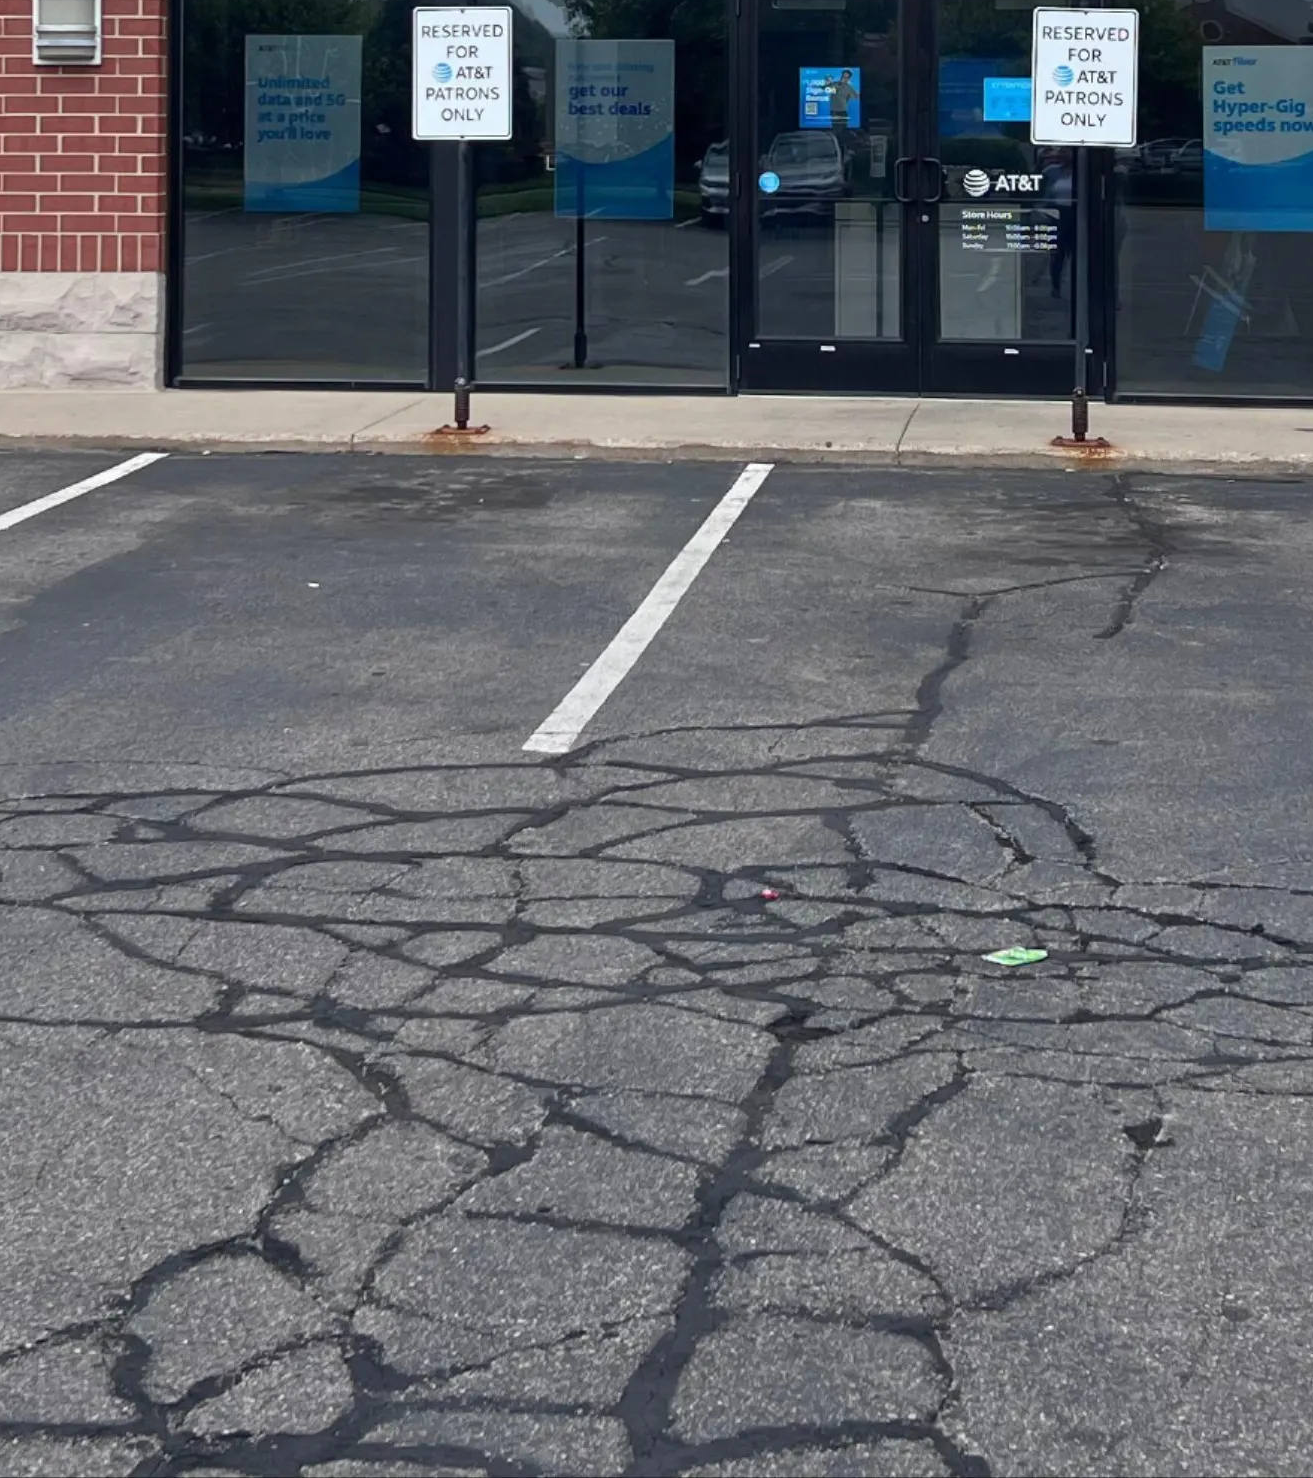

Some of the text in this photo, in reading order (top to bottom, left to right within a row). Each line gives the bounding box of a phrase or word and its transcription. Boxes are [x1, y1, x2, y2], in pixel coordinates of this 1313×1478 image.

[421, 24, 504, 38] RESERVED
[1042, 26, 1130, 42] RESERVED
[446, 45, 479, 58] FOR
[1068, 48, 1103, 62] FOR
[455, 66, 493, 79] AT&T
[1077, 70, 1118, 84] AT&T
[257, 75, 330, 89] Unlimited
[1213, 80, 1246, 95] Get
[257, 92, 346, 106] data and 5G
[425, 87, 500, 101] PATRONS
[568, 84, 629, 100] get our
[1044, 90, 1124, 106] PATRONS
[441, 108, 485, 122] ONLY
[568, 101, 652, 116] best deals
[1213, 98, 1306, 118] Hyper-Gig
[288, 109, 326, 126] price
[1060, 112, 1107, 127] ONLY
[300, 125, 331, 140] love
[1213, 117, 1276, 136] speeds
[994, 174, 1043, 192] AT&T
[962, 210, 1013, 220] Store Hours
